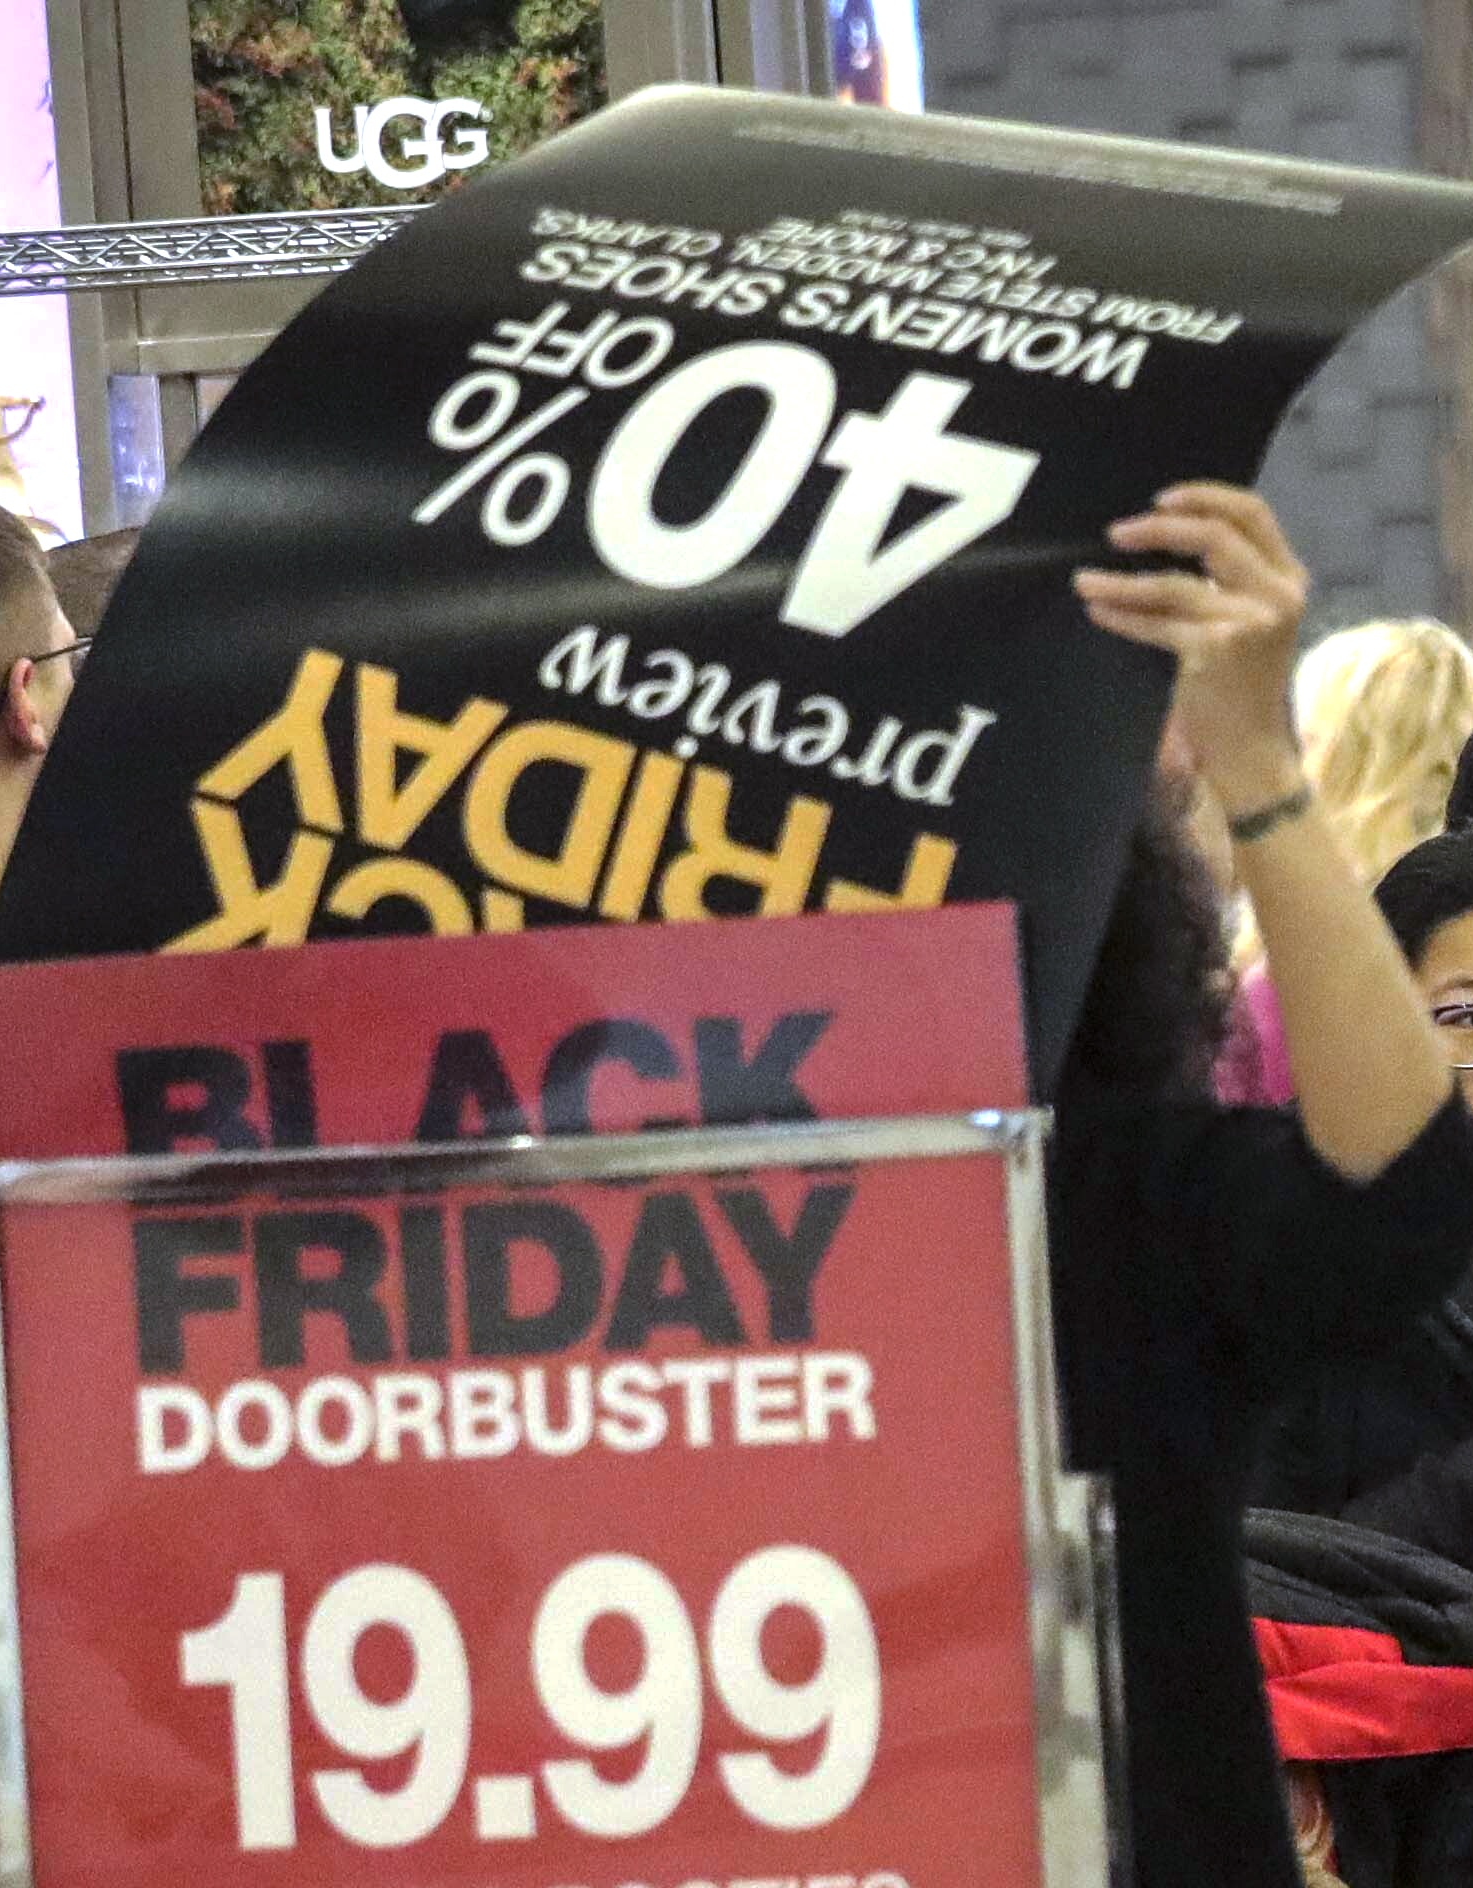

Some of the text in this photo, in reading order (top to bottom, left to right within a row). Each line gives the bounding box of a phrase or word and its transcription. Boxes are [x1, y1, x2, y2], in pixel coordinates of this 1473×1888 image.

[314, 95, 490, 189] UGG
[762, 214, 909, 258] MORE
[468, 300, 675, 389] OFF
[518, 239, 1152, 391] WOMEN'S SHOES
[935, 272, 1099, 317] STEVE
[1090, 294, 1247, 345] FROM
[537, 622, 999, 807] preview
[132, 1186, 858, 1376] FRIDAY
[136, 1350, 879, 1476] DOORBUSTER
[177, 1542, 883, 1853] 19.99
